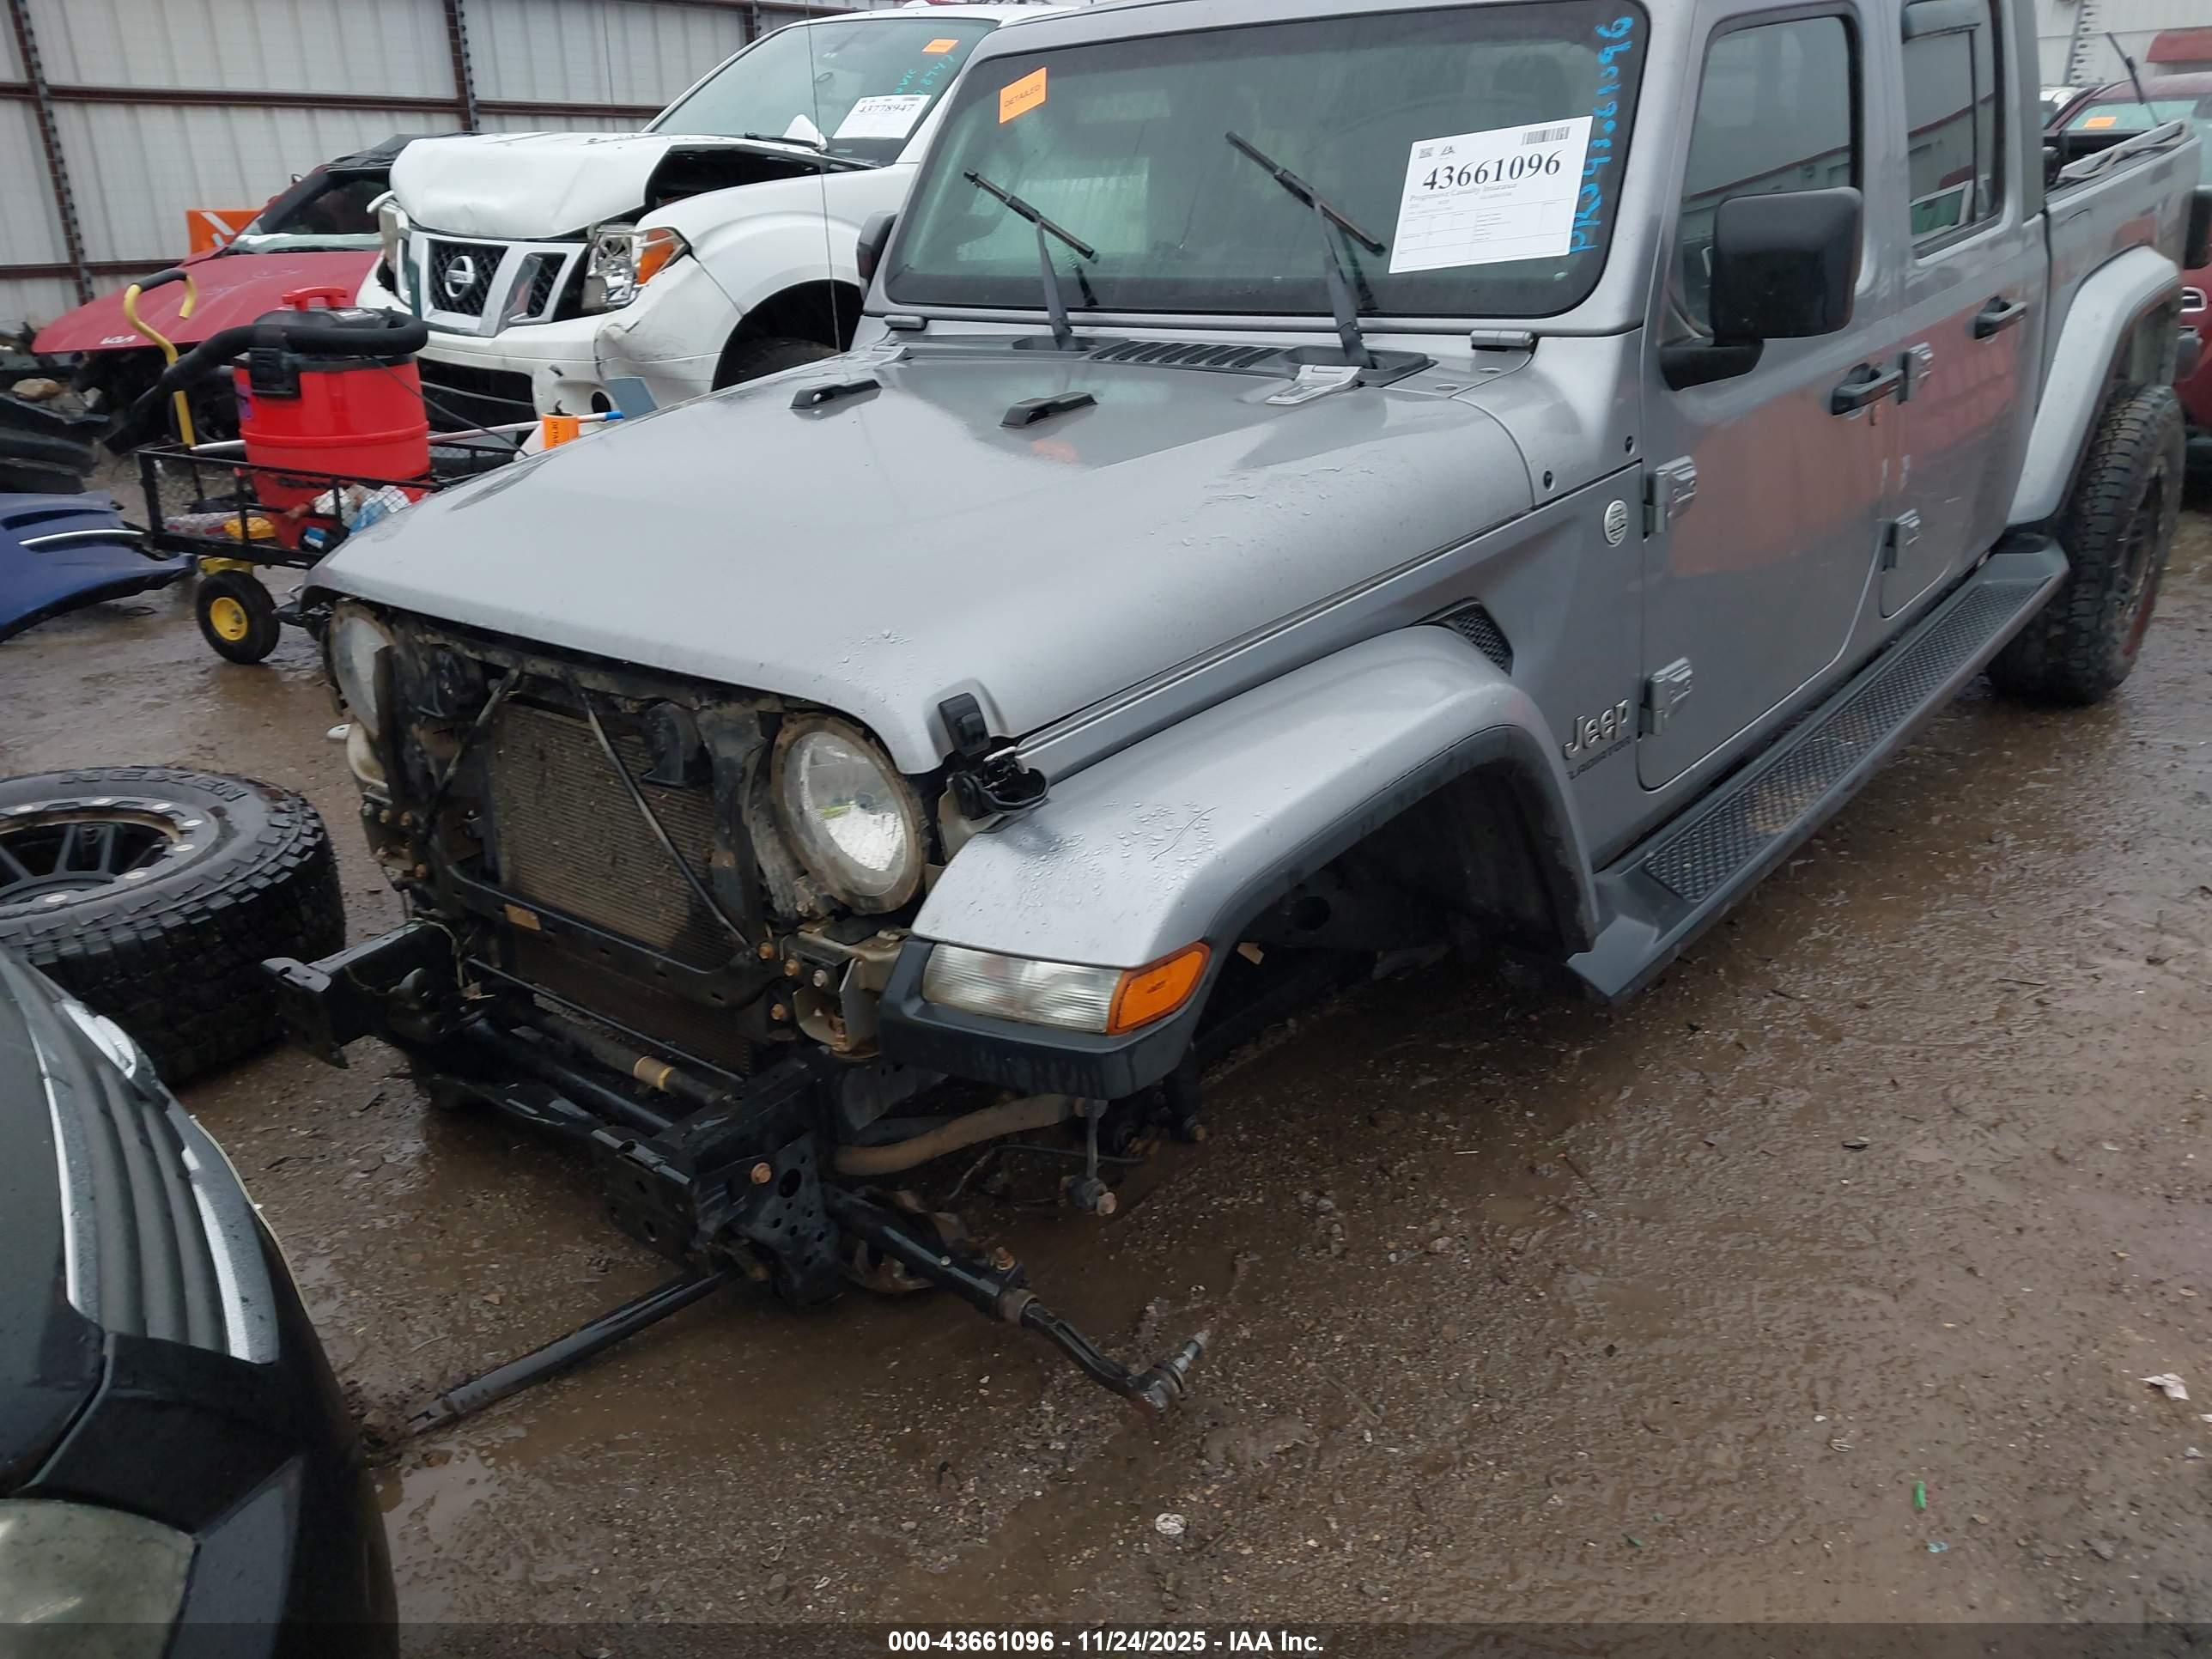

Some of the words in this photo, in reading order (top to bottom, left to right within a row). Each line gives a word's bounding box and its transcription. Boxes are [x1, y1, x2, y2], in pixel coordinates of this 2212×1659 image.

[1004, 83, 1042, 108] DETAILED
[1422, 149, 1564, 191] 43661096
[1562, 698, 1630, 760] Jeep
[58, 769, 249, 802] NEXEN
